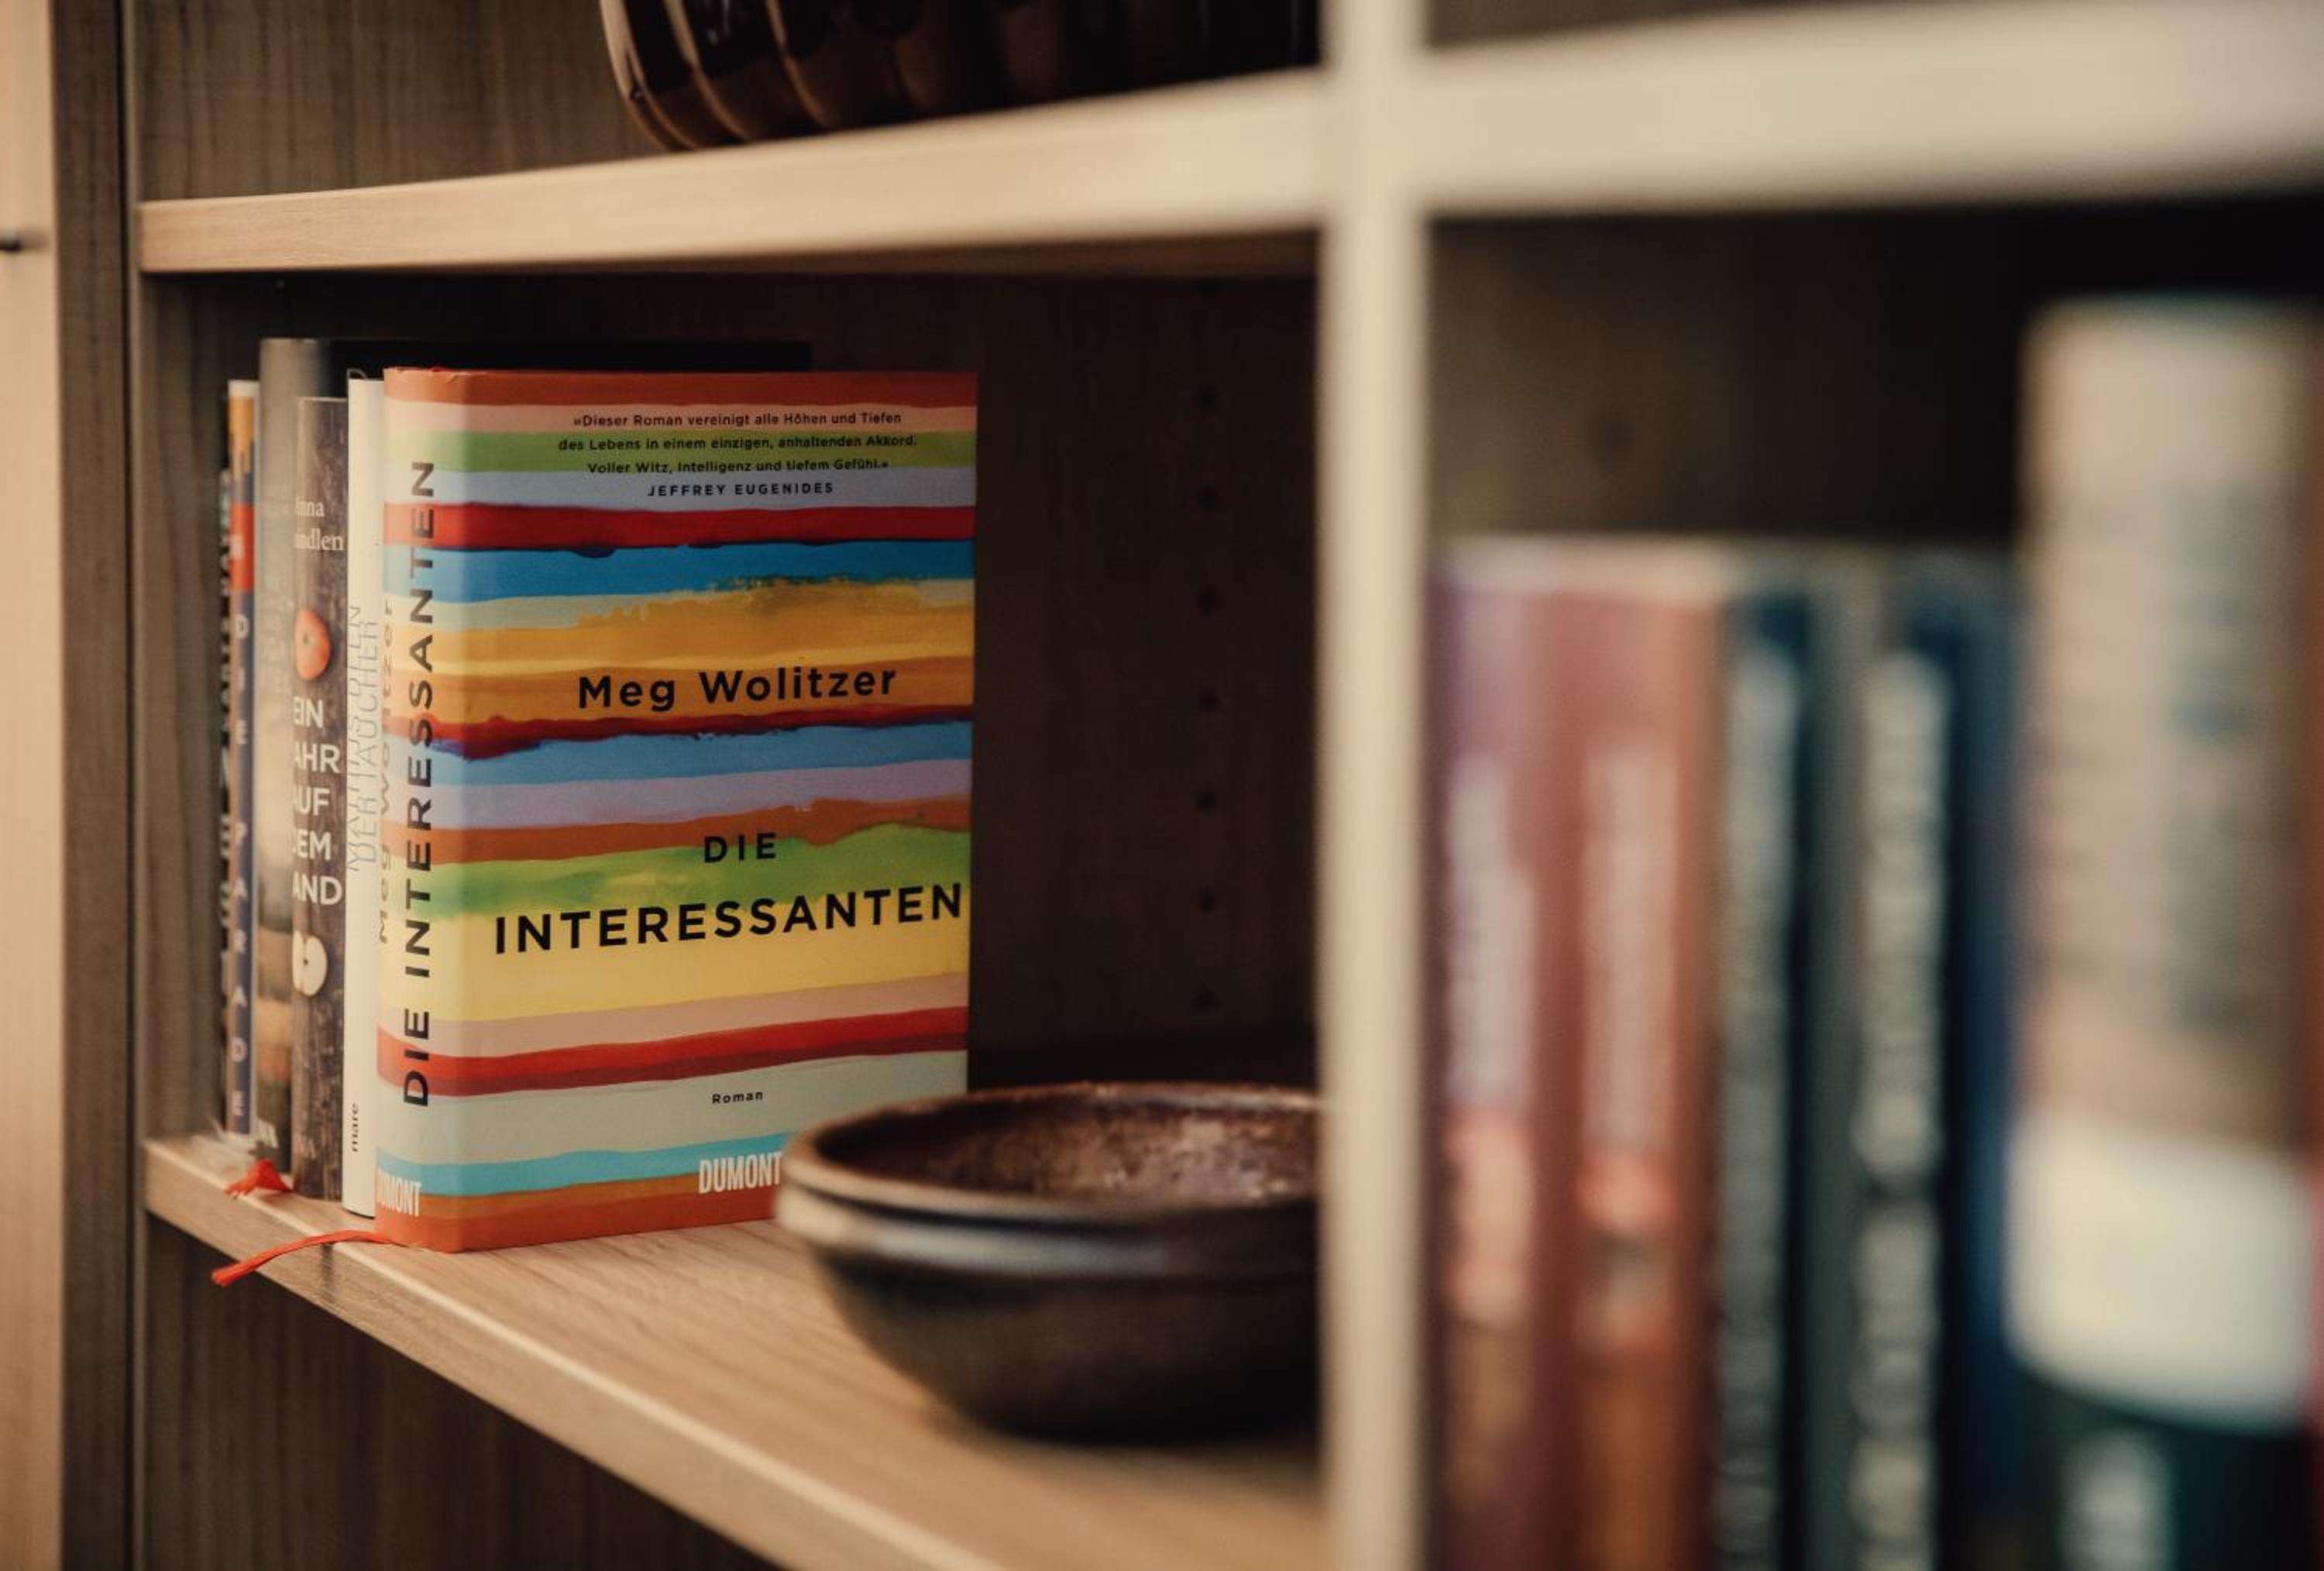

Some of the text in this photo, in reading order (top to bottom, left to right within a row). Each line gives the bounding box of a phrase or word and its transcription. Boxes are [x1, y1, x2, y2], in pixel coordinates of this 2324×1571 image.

[634, 414, 682, 425] Roman
[688, 413, 749, 428] vereinigt
[755, 413, 779, 425] alle
[784, 412, 827, 425] Höhen
[831, 413, 856, 424] und
[861, 411, 902, 424] Tiefen
[559, 434, 917, 451] des Lebens in einem einzigen, anhaltenden Akkord.
[588, 462, 630, 474] Voller
[635, 461, 673, 474] Witz,
[678, 460, 751, 473] Intelligenz
[756, 459, 782, 471] und
[786, 459, 830, 470] tiefem
[648, 482, 834, 497] JEFFREY EUGENIDES
[579, 666, 896, 712] Meg Wolitzer
[404, 462, 435, 1107] DIE INTERESSANTEN
[703, 832, 778, 864] DIE
[496, 882, 962, 955] INTERESSANTEN
[712, 1091, 764, 1105] Roman
[699, 1151, 782, 1195] DUMONT
